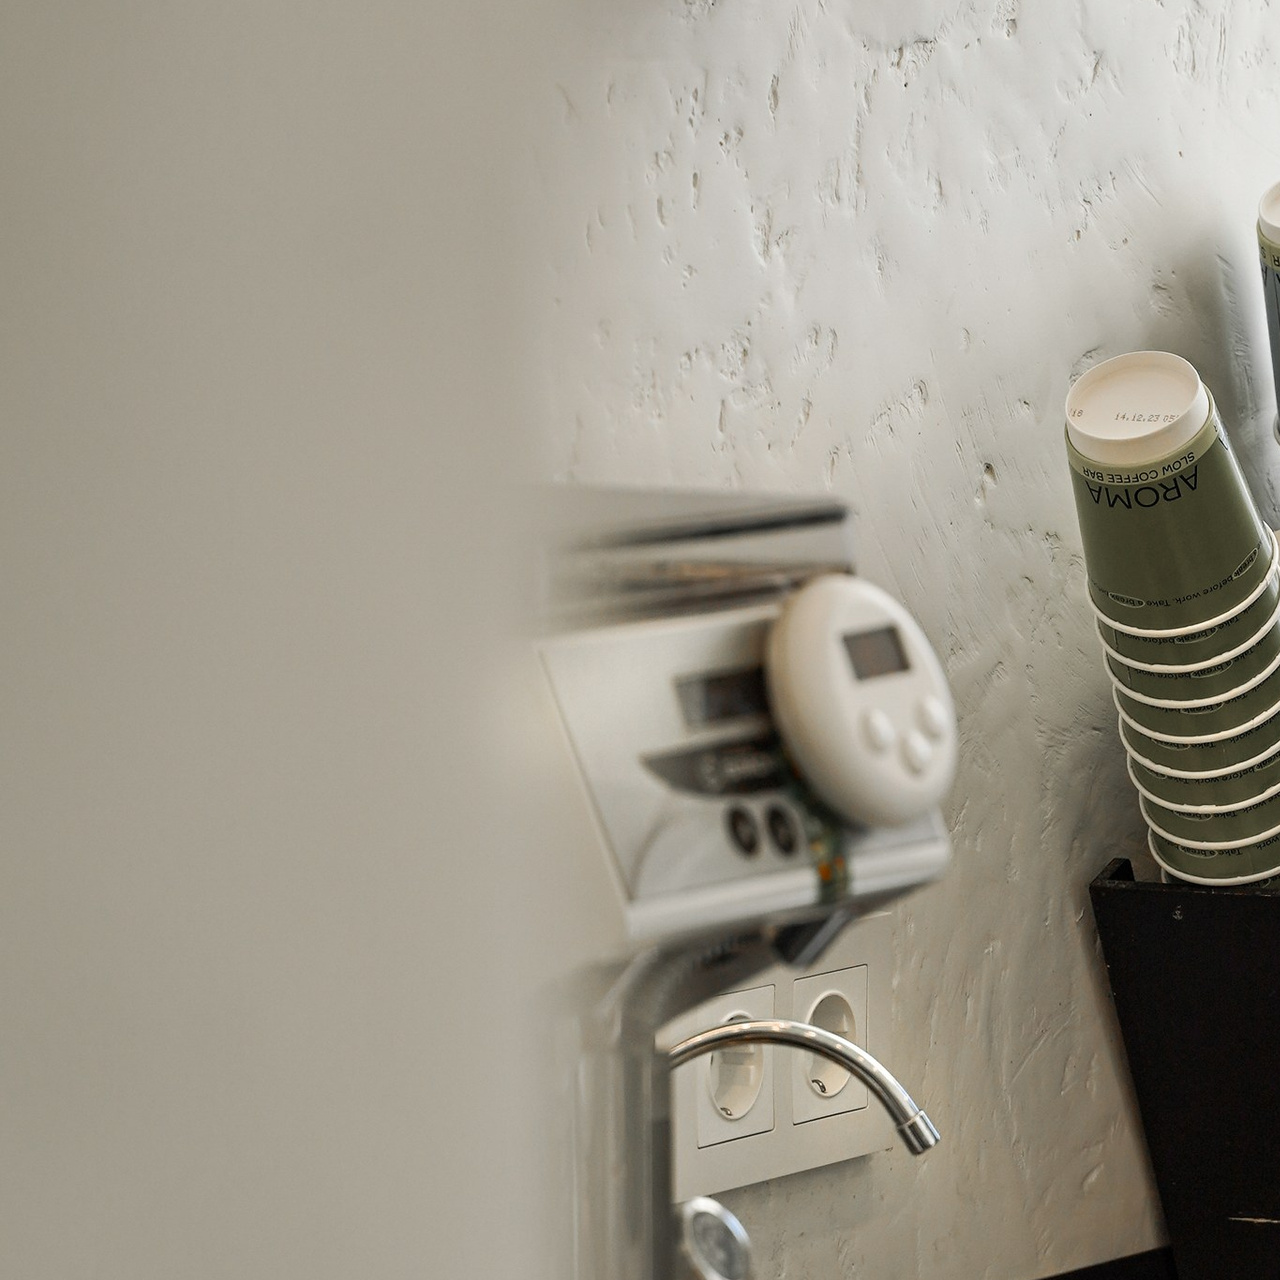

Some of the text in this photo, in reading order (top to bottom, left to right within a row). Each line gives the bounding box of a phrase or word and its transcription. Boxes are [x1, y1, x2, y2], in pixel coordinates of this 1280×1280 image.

[1083, 451, 1195, 484] SLOW COFFEE BAR
[1085, 464, 1198, 509] AROMA
[1203, 575, 1233, 596] before
[1146, 599, 1171, 608] Take
